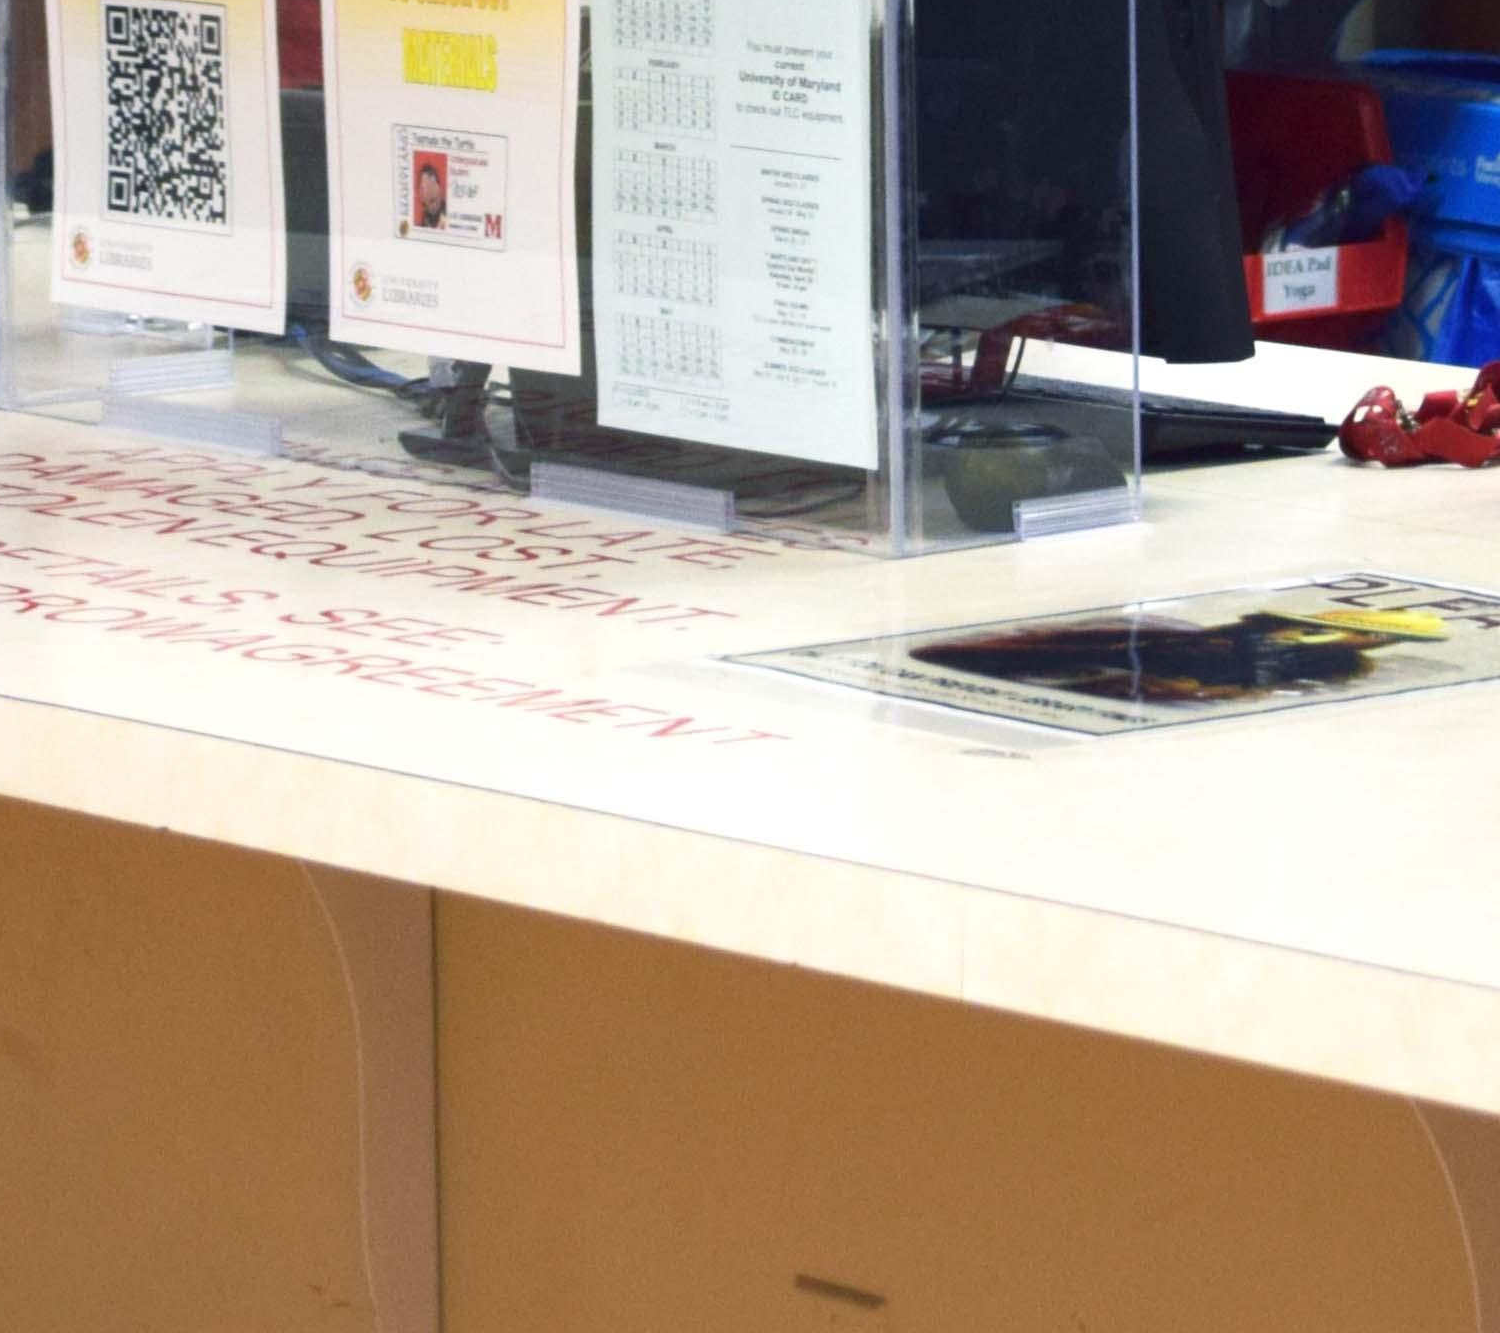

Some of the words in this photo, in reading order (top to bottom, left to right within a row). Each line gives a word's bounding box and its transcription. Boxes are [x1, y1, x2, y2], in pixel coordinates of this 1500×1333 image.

[739, 71, 784, 89] University
[799, 77, 842, 94] Maryland
[66, 447, 368, 491] APPLY
[329, 489, 542, 527] FOR
